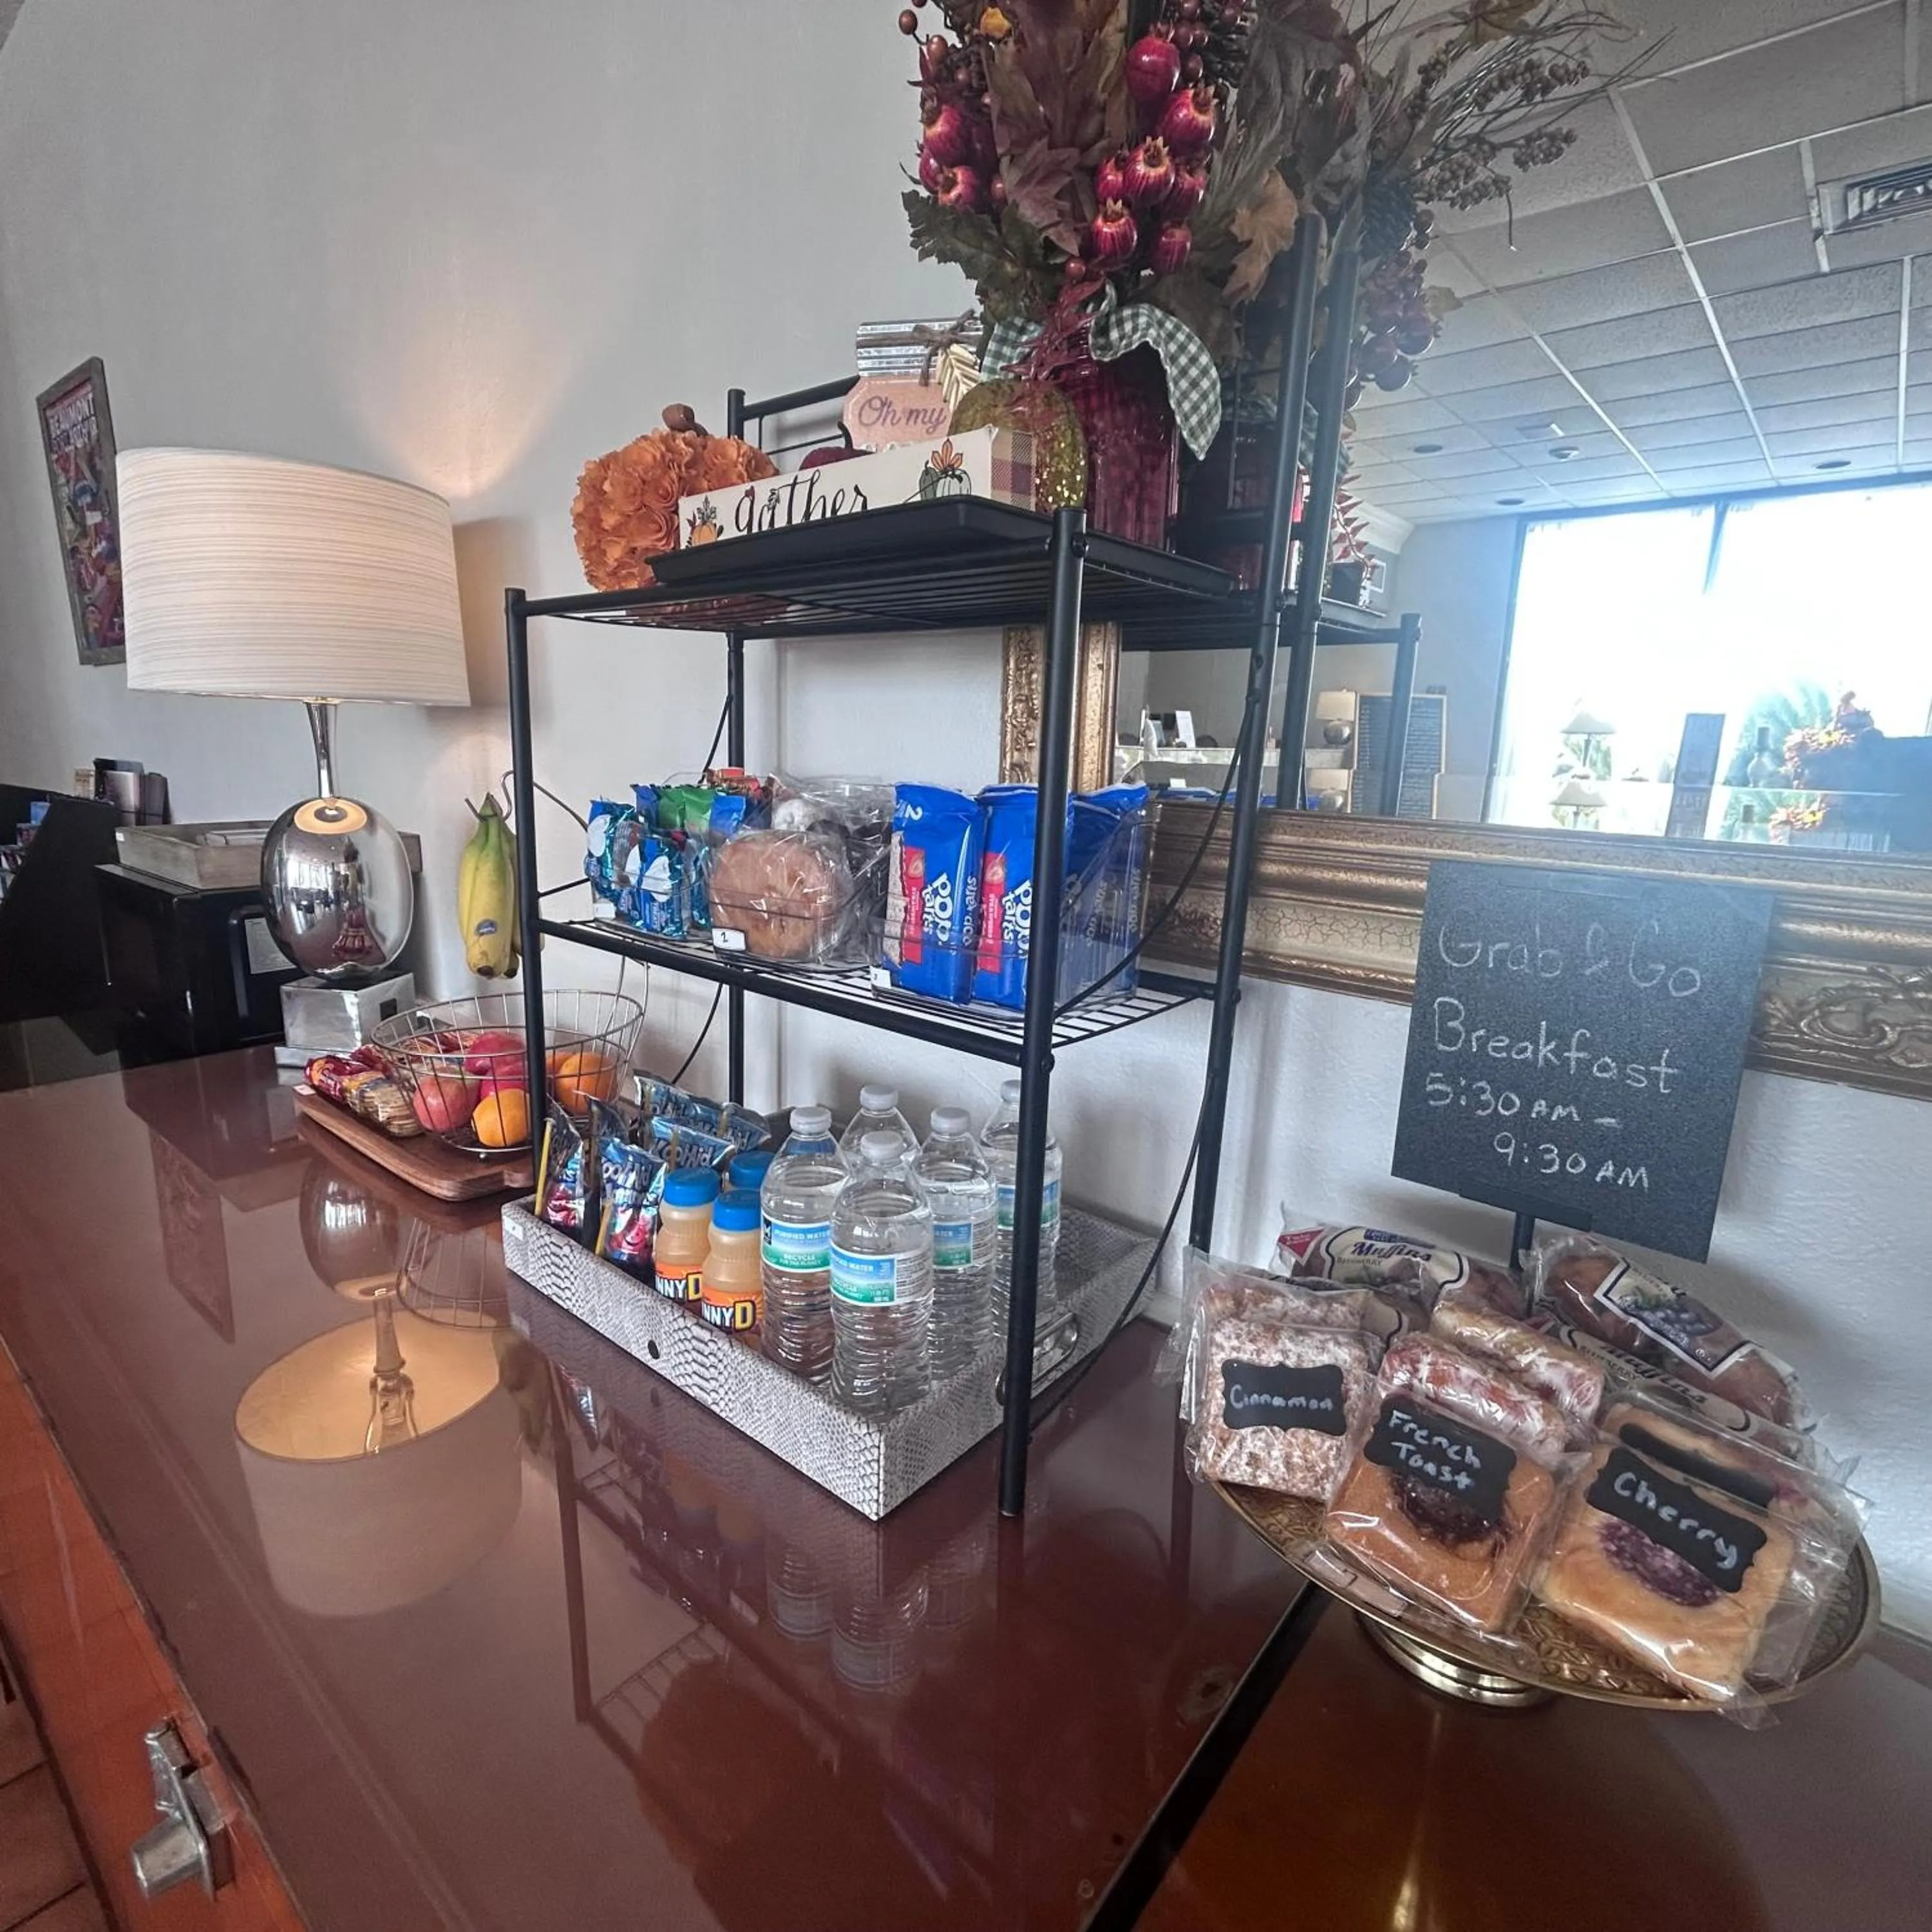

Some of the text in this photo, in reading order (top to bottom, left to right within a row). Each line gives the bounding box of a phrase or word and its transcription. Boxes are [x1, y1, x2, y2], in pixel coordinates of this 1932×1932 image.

[858, 395, 947, 435] Oh my
[1439, 923, 1564, 978] Grab
[1629, 921, 1701, 997] Go
[1434, 996, 1679, 1094] Breakfast
[1426, 1072, 1520, 1116] 5:30
[1530, 1099, 1580, 1121] AM
[1493, 1132, 1649, 1193] 9:30 AM
[1351, 1240, 1433, 1262] Muffins
[701, 1300, 756, 1332] NNYD
[1229, 1383, 1334, 1412] Cinnamon
[1388, 1409, 1482, 1470] French
[1390, 1441, 1474, 1490] Toast
[1613, 1471, 1738, 1570] Cherry
